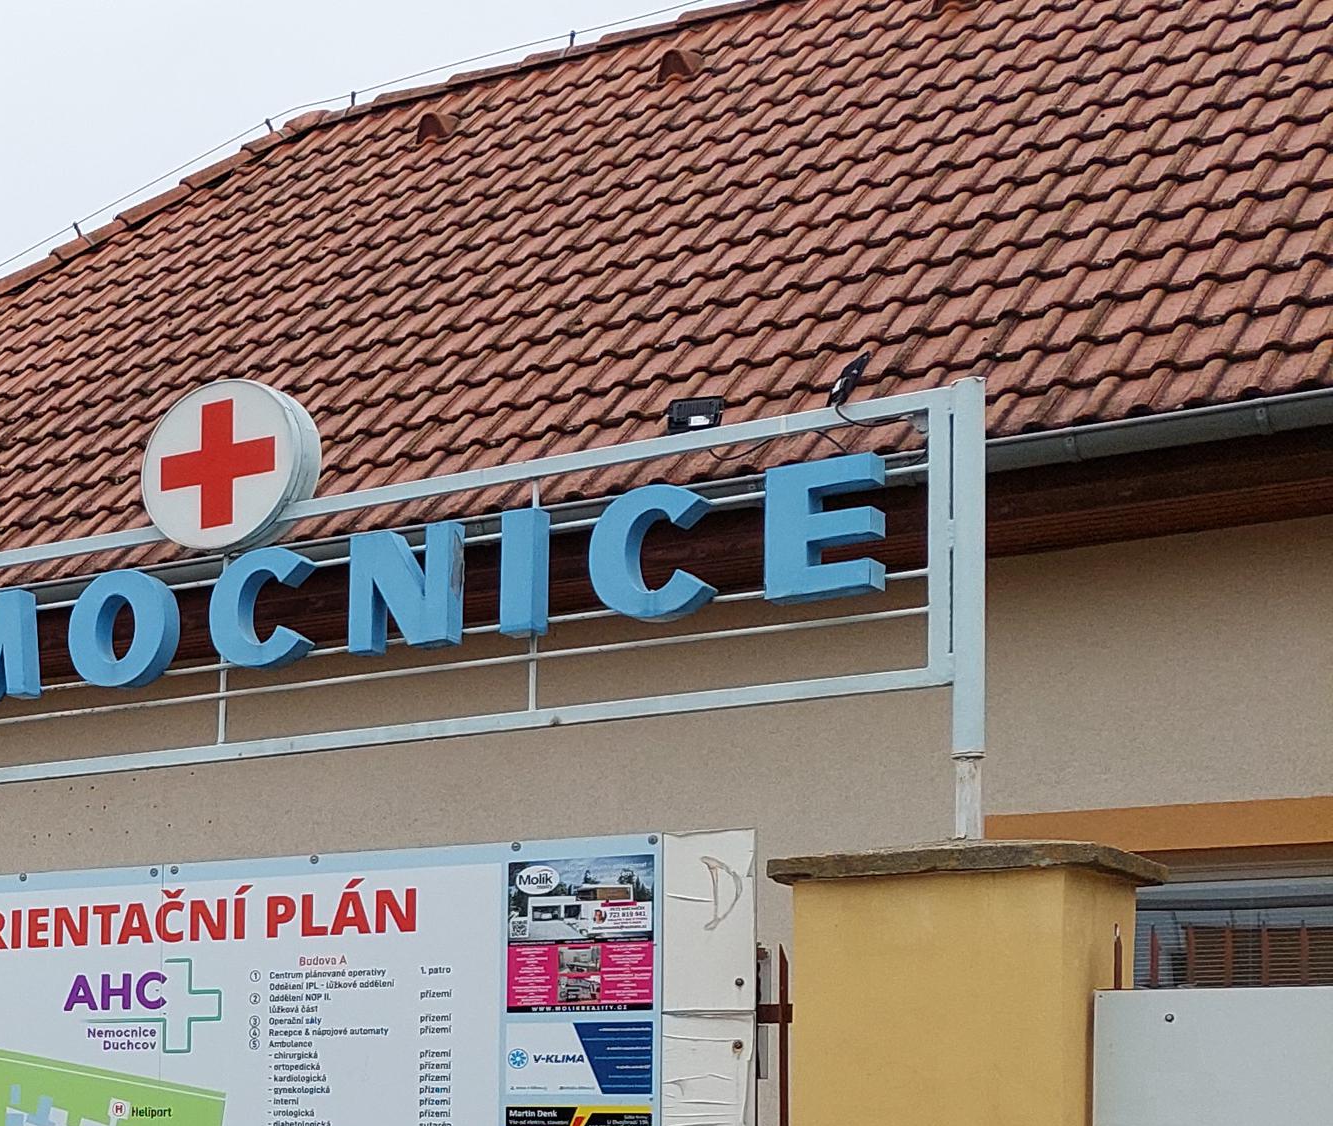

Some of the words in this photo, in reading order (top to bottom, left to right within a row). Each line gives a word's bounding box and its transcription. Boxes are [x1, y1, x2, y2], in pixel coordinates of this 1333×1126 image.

[267, 878, 417, 938] PLÁN
[299, 956, 336, 966] Budova
[339, 955, 347, 965] A
[270, 971, 303, 980] Centrum
[305, 969, 346, 981] plánované
[348, 968, 386, 979] operativy
[429, 966, 451, 975] patro
[270, 982, 303, 991] Oddělení
[306, 982, 318, 990] IPL
[326, 980, 357, 989] lůžkové
[360, 979, 394, 988] oddělení
[63, 972, 167, 1012] AHC
[420, 989, 452, 999] přízemí
[270, 993, 303, 1002] Oddělení
[269, 1004, 299, 1014] lůžková
[301, 1005, 318, 1013] část
[269, 1017, 303, 1026] Operační
[305, 1017, 322, 1026] sály
[420, 1014, 451, 1023] přízemí
[88, 1027, 156, 1039] Nemocnice
[269, 1028, 302, 1038] Recepce
[312, 1027, 347, 1036] nápojové
[350, 1027, 389, 1036] automaty
[103, 1039, 156, 1051] Duchcov
[269, 1040, 312, 1048] Ambulance
[274, 1051, 318, 1060] chirurgická
[420, 1049, 451, 1059] přízemí
[533, 1054, 584, 1063] V-KLIMA
[274, 1063, 320, 1071] ortopedická
[274, 1074, 326, 1083] kardiologická
[274, 1086, 330, 1095] gynekologická
[274, 1097, 299, 1105] interní
[131, 1106, 172, 1118] Heliport
[273, 1109, 314, 1118] urologická
[537, 1109, 557, 1117] Denk
